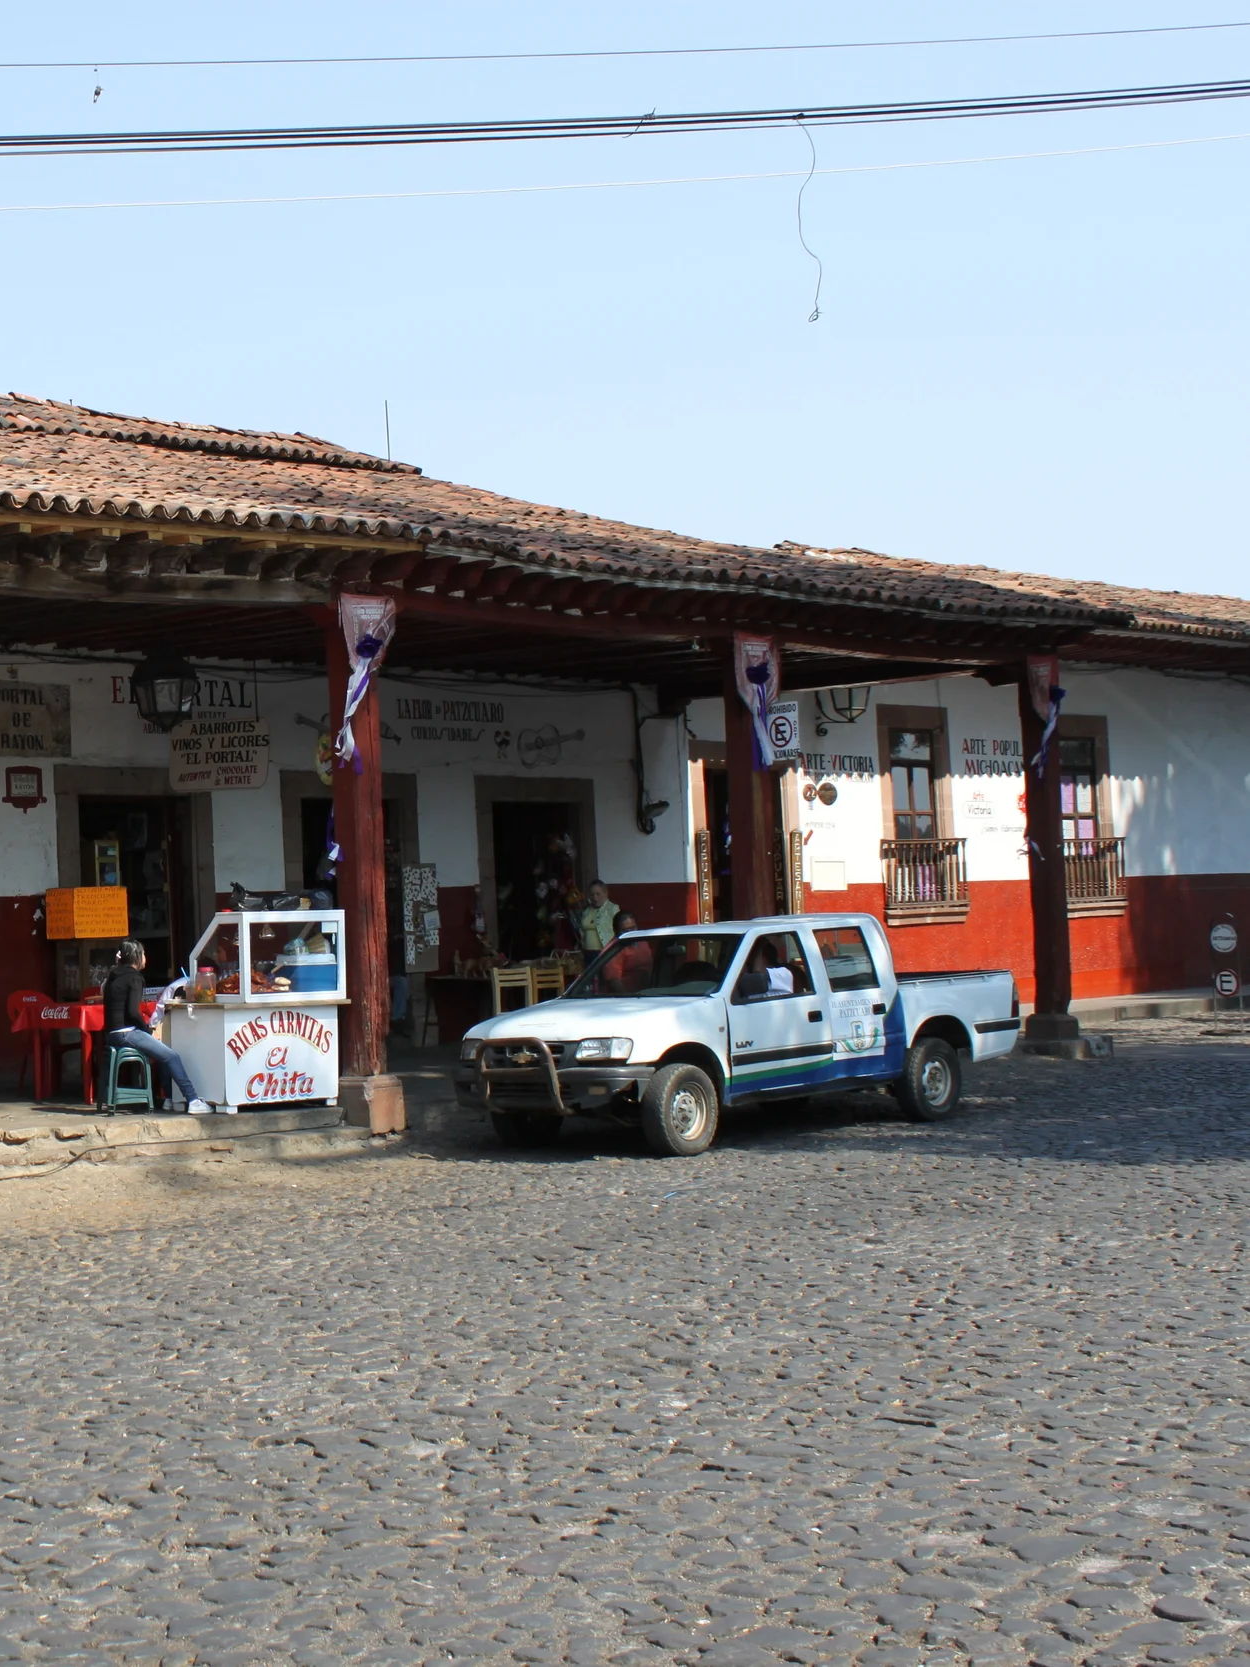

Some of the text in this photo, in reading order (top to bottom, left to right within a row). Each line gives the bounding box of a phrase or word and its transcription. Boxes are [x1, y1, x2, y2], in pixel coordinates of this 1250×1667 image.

[442, 700, 504, 723] PATZCUARO
[768, 702, 797, 716] ROHIBIDO
[12, 711, 32, 728] DE
[190, 720, 255, 736] ABARROTES
[0, 733, 44, 751] RAYON
[171, 734, 270, 752] VINOS Y LICORES
[410, 726, 485, 742] CURIOSIDADES
[962, 738, 1023, 757] ARTE POPUL
[216, 765, 258, 775] CHOCOLATE
[224, 776, 252, 785] METATE
[226, 1010, 334, 1061] RICAS CARNITAS
[266, 1046, 289, 1070] El
[246, 1070, 315, 1102] Chita
